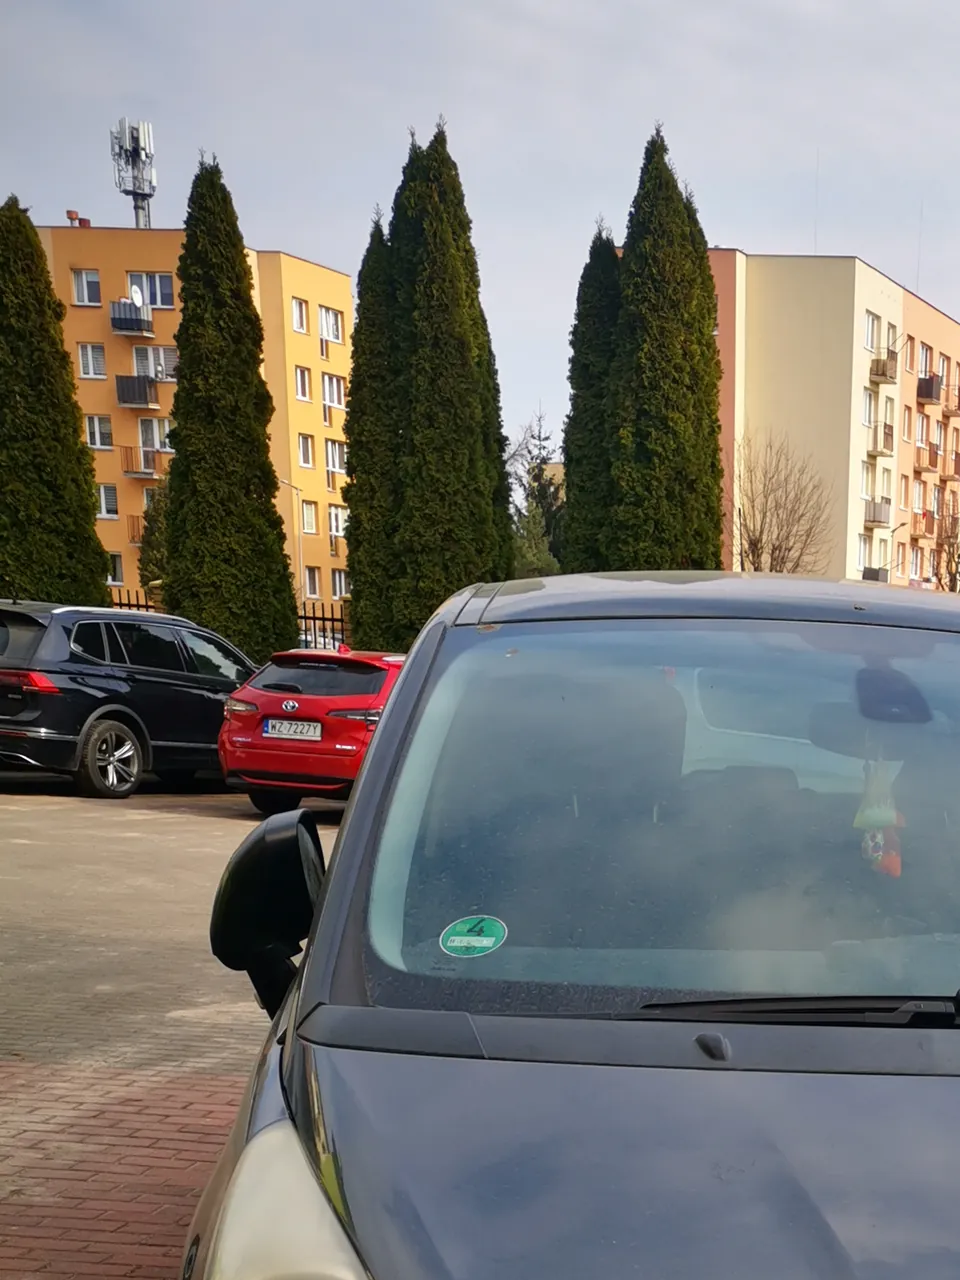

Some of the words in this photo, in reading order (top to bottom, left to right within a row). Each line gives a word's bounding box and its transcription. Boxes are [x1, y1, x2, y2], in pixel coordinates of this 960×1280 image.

[270, 721, 284, 732] WZ
[287, 722, 318, 735] 7227Y
[467, 918, 486, 936] 4
